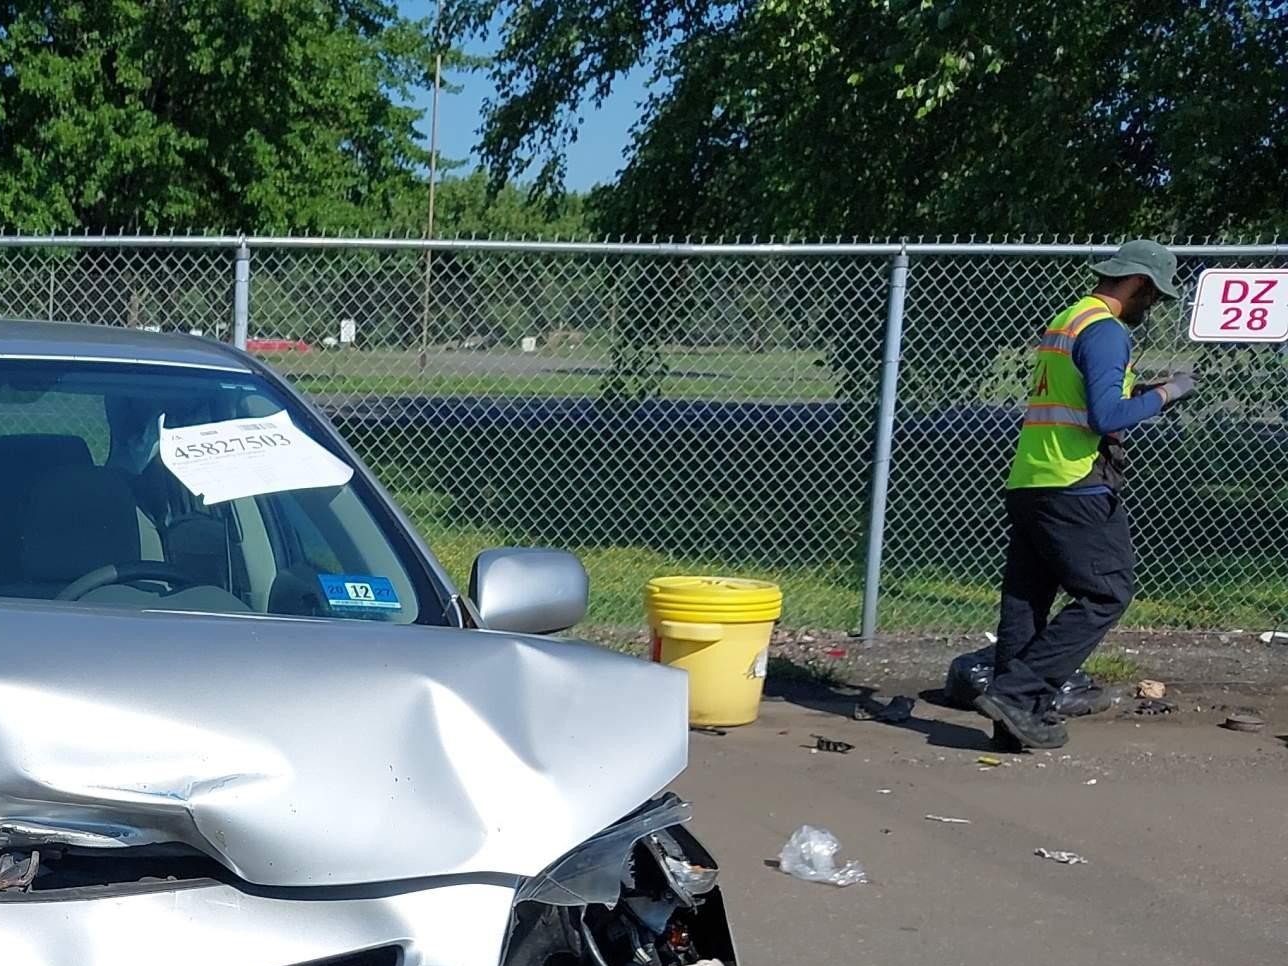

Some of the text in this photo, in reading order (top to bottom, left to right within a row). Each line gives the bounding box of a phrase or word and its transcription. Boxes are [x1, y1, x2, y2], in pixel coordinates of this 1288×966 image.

[1221, 280, 1278, 304] DZ
[1220, 307, 1268, 331] 28
[175, 433, 291, 459] 45827503
[351, 585, 372, 598] 12
